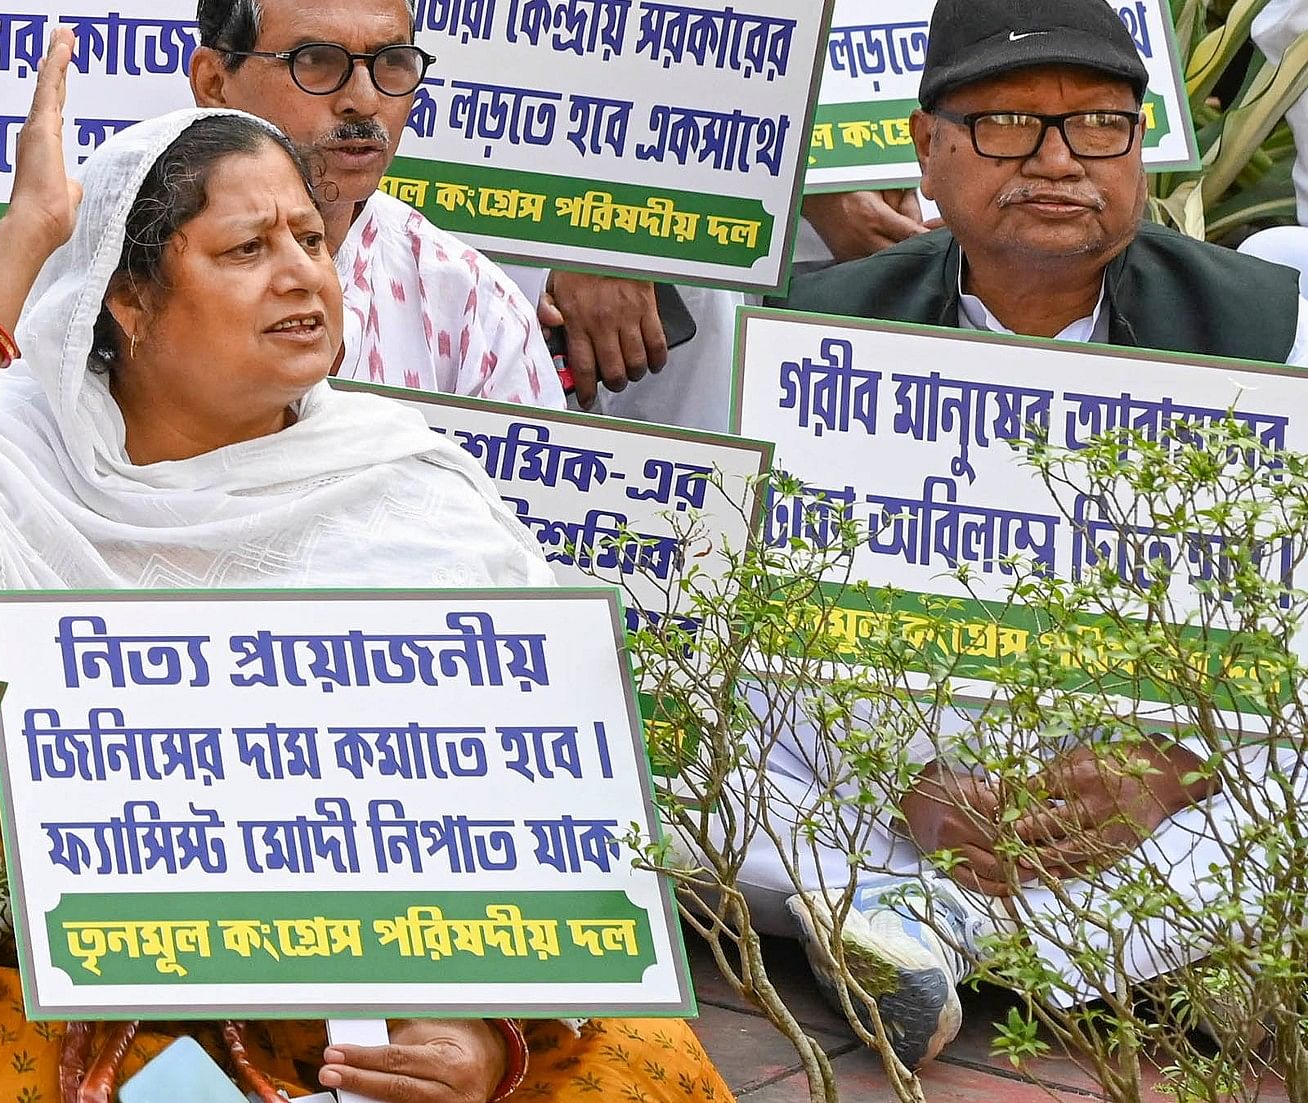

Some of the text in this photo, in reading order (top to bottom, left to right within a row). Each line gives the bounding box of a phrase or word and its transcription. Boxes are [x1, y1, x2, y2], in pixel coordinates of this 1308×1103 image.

[634, 1, 795, 81] সরকারের
[448, 80, 561, 158] লড়তে
[566, 94, 632, 157] হবে
[634, 105, 788, 178] একসাথে
[435, 182, 758, 248] কংগ্রেস পরিষদীয় দল
[778, 337, 881, 438] গরীব
[54, 611, 548, 694] নিত্য প্রয়োজনীয়
[21, 707, 223, 787] জিনিসের
[230, 722, 319, 781] দাম
[326, 722, 486, 780] কমাতে
[494, 726, 581, 782] হবে
[39, 797, 619, 876] ফ্যাসিস্ট মোদী নিপাত যাক
[217, 916, 361, 958] কংগ্রেস
[373, 903, 558, 960] পরিষদীয়
[566, 918, 636, 956] দল
